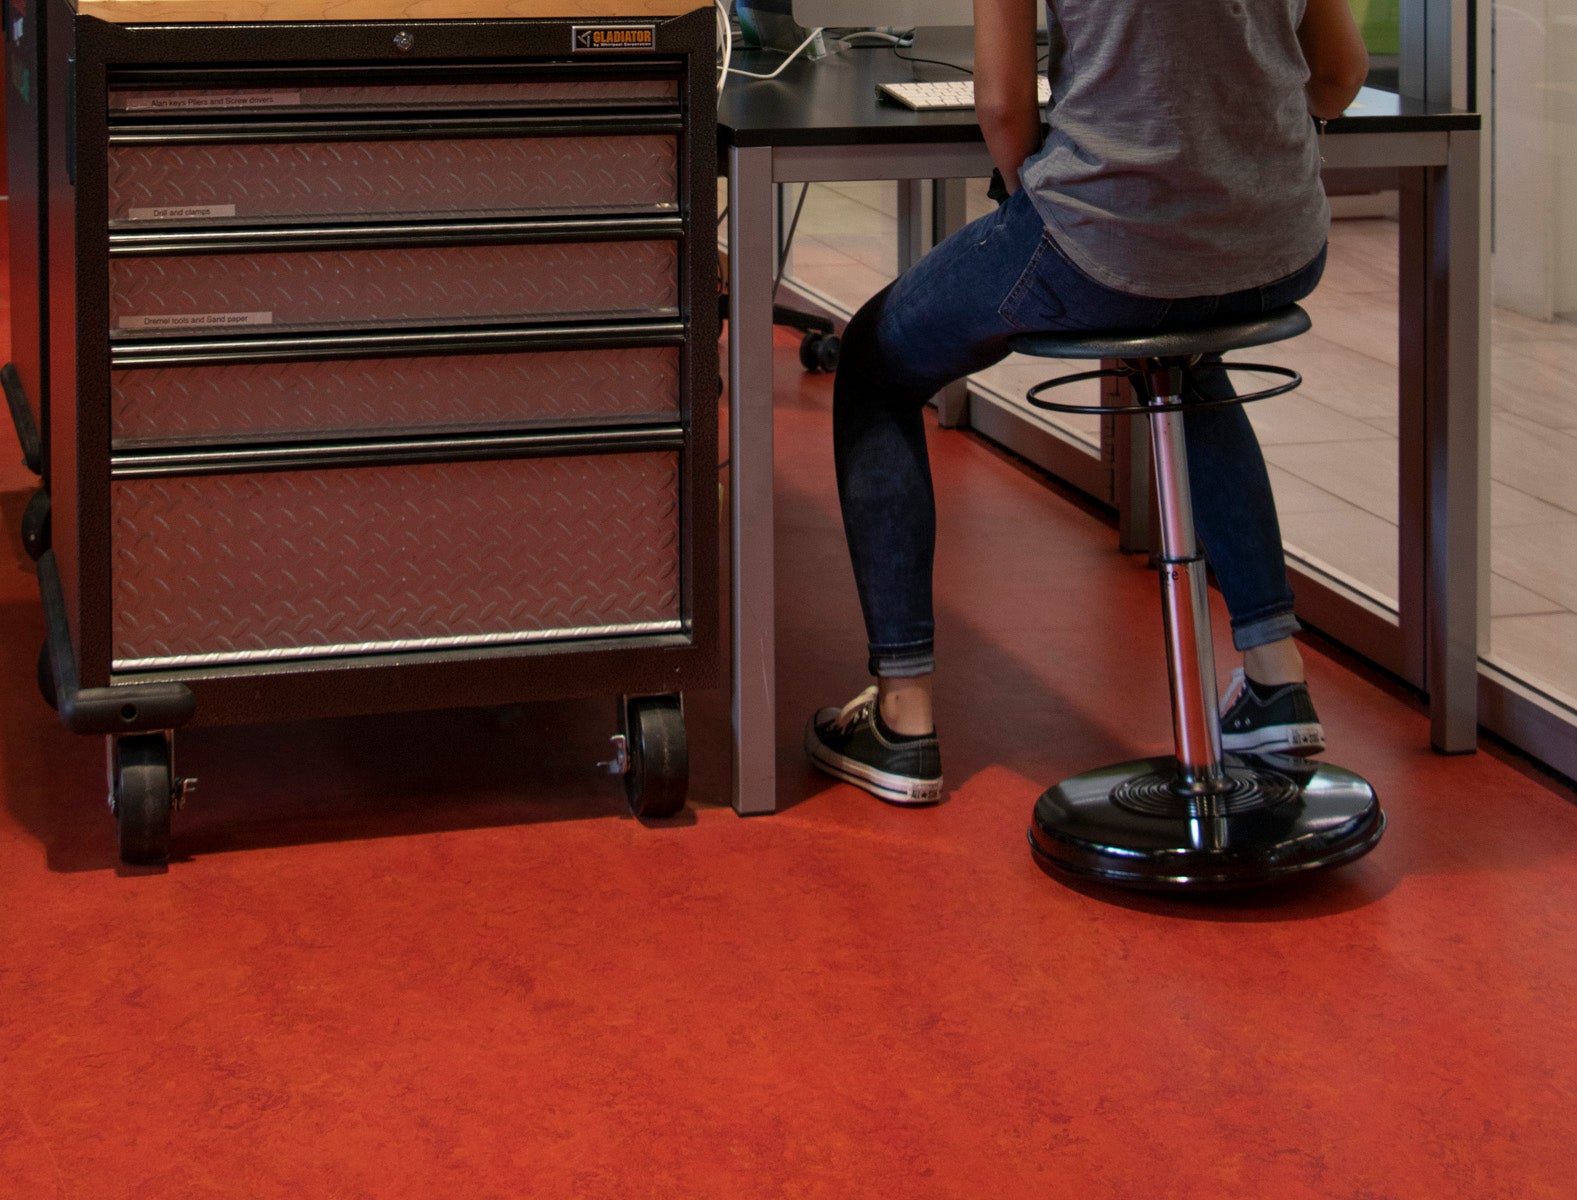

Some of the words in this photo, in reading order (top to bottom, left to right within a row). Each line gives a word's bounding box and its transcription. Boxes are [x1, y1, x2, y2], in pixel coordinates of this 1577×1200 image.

[593, 30, 652, 43] GLADIATOR
[151, 99, 168, 107] Alan
[169, 99, 186, 108] keys
[188, 98, 208, 106] Pliers
[210, 97, 224, 105] and
[225, 96, 248, 104] Screw
[249, 96, 274, 104] drivers
[153, 209, 168, 217] Drill
[184, 208, 211, 217] clamps
[143, 316, 169, 325] Dremel
[171, 316, 189, 325] tools
[190, 316, 205, 324] and
[206, 315, 226, 324] Sand
[227, 315, 248, 325] paper
